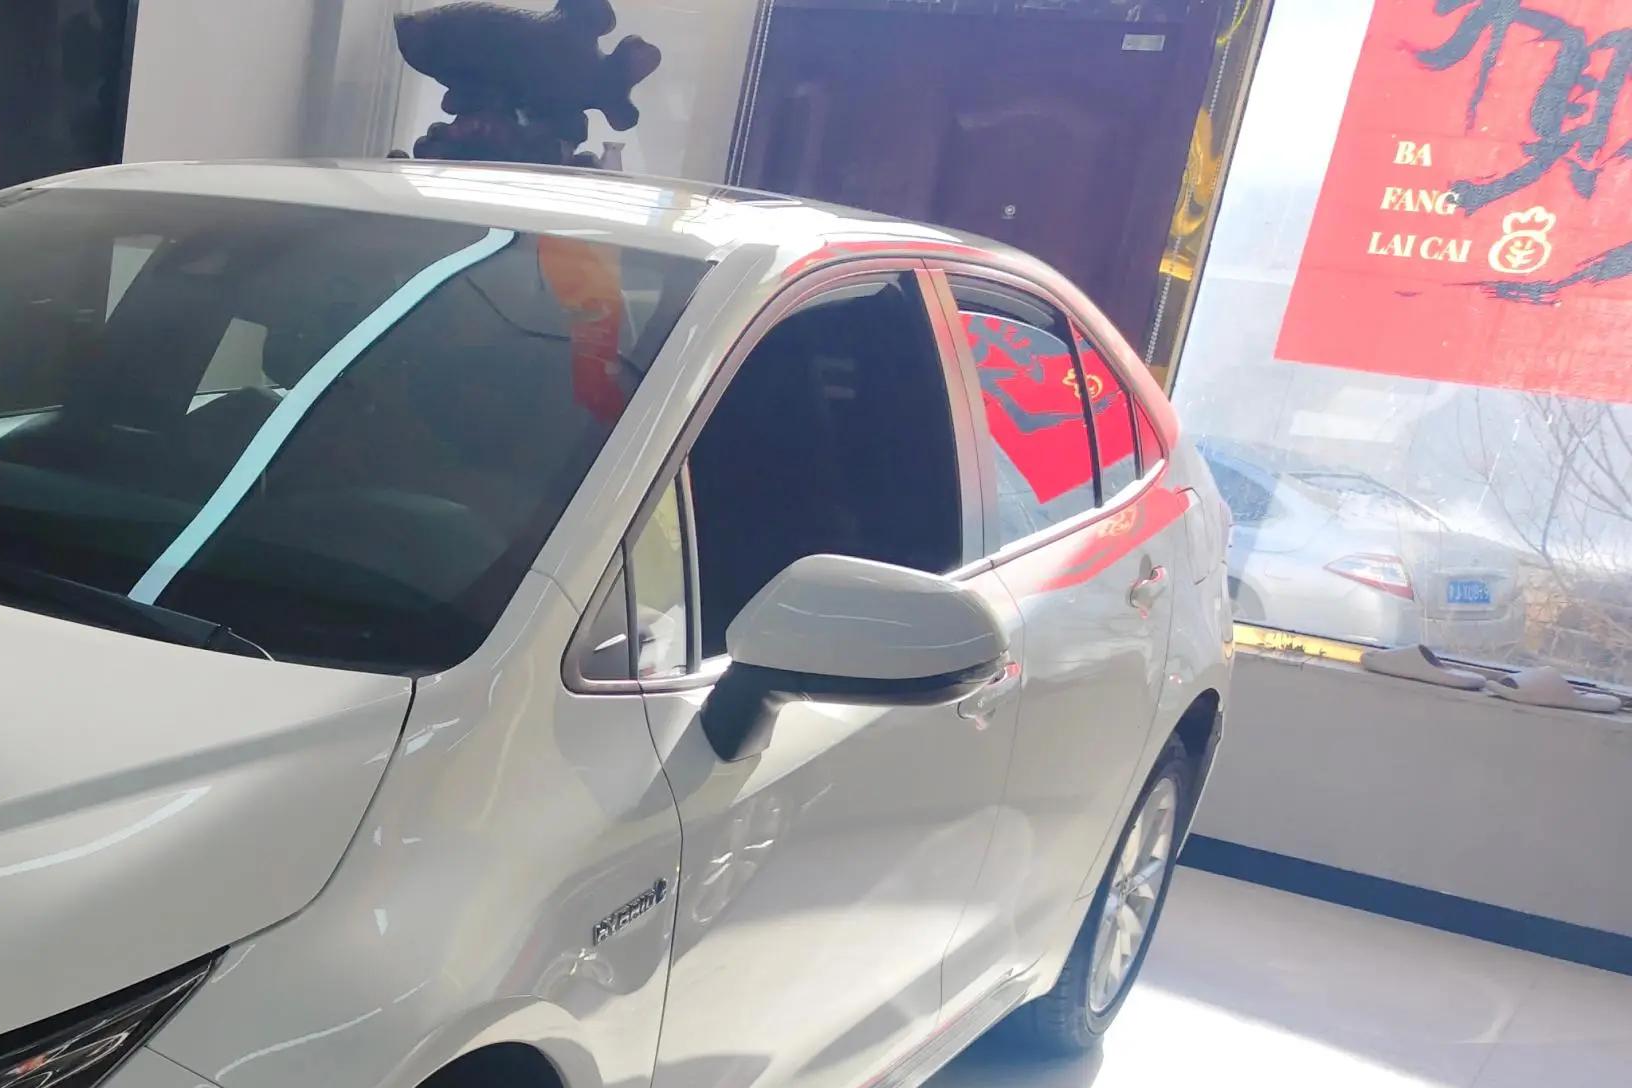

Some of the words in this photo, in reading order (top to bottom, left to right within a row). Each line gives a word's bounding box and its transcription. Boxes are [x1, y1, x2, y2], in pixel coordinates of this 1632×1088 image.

[1394, 141, 1432, 167] BA
[1380, 186, 1460, 216] FANG
[1367, 231, 1417, 258] LAI
[1419, 235, 1473, 263] CAI
